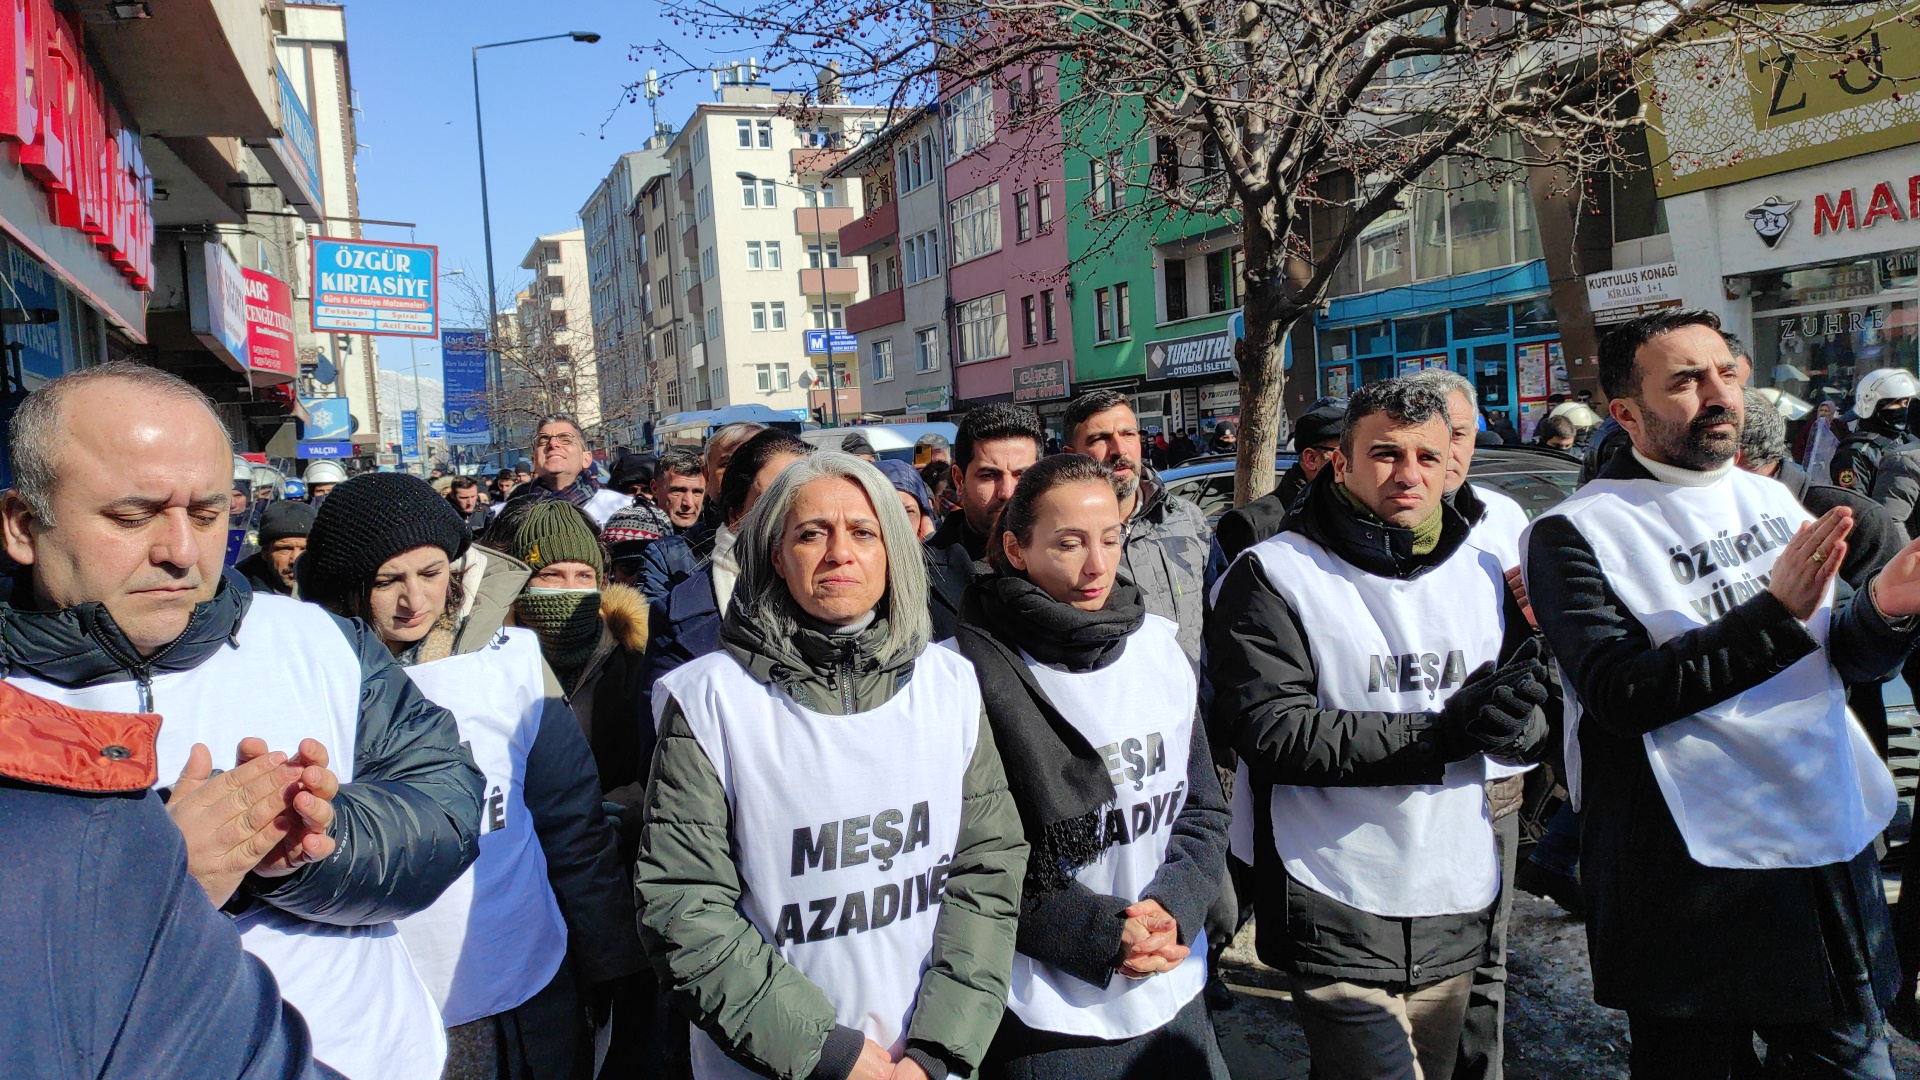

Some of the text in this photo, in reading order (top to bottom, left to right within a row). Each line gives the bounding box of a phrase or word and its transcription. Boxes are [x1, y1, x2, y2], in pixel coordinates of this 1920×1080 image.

[1814, 175, 1920, 236] MA
[335, 246, 411, 273] ÖZGÜR
[244, 277, 268, 302] KARS
[322, 272, 428, 297] KIRTASİYE
[1588, 264, 1678, 290] KURTULUŞ KONAĞI
[323, 294, 341, 304] Büro
[350, 296, 381, 307] Kırtasiye
[382, 299, 426, 309] Malzemeleri
[1607, 283, 1662, 299] KİRALIK 1+1
[246, 304, 274, 326] CENGİZ
[324, 308, 368, 317] Fotokopi
[391, 312, 417, 320] Spiral
[404, 323, 427, 332] Kaşe
[811, 337, 823, 349] M
[1173, 363, 1202, 375] OTOBÜS
[309, 446, 337, 456] YALÇIN
[1669, 513, 1795, 585] ÖZGÜRLÜK
[1368, 650, 1467, 700] MEŞA
[1096, 732, 1166, 792] EŞA
[790, 800, 930, 872] MEŞA
[777, 853, 951, 947] AZADIYÊ
